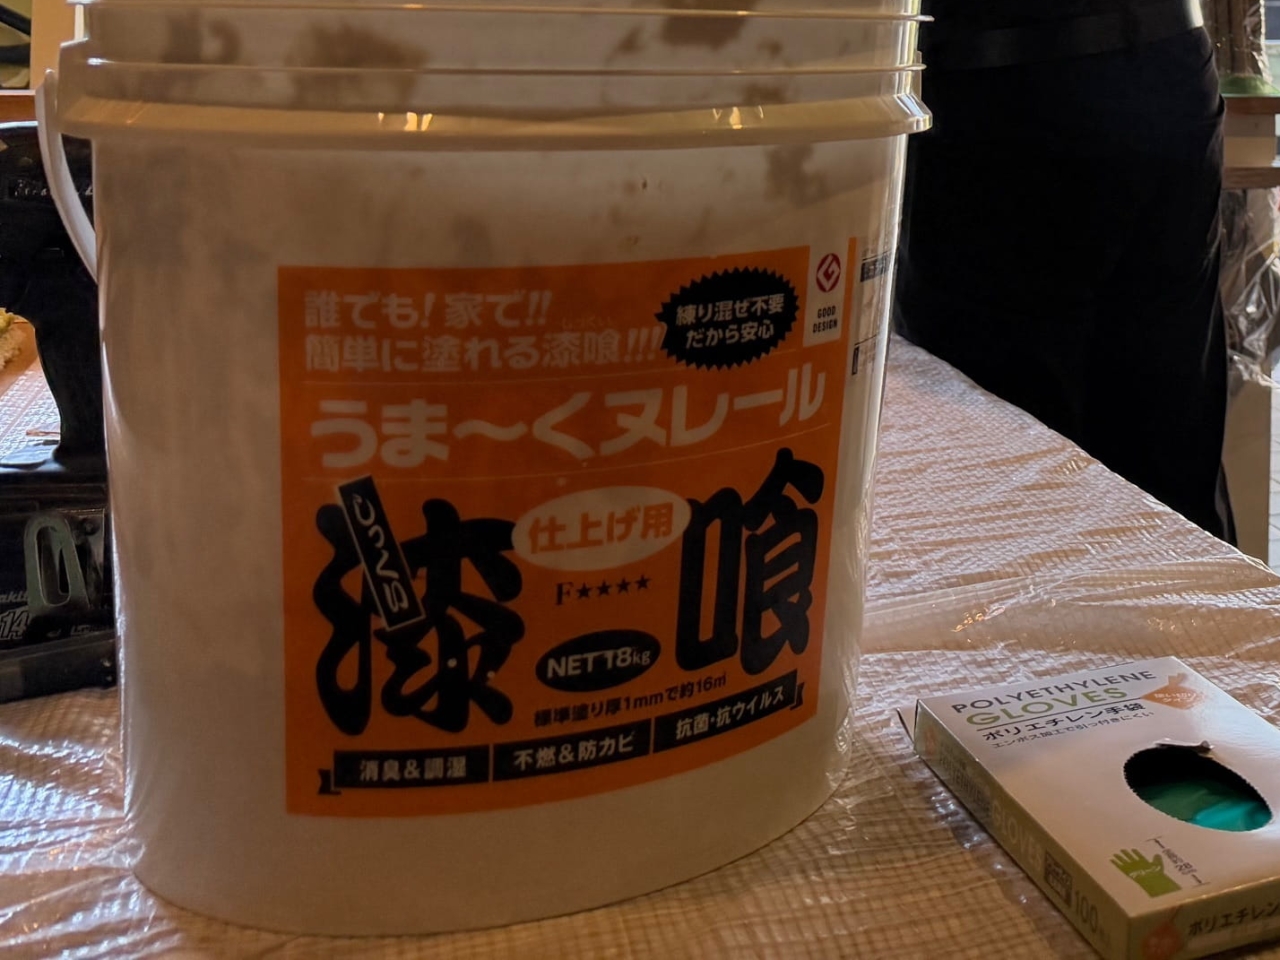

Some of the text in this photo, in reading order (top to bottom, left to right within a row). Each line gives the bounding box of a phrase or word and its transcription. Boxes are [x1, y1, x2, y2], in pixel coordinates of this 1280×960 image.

[676, 293, 785, 327] 練り混ぜ不要
[812, 319, 838, 333] DESIGN
[817, 305, 837, 319] GOOD
[685, 319, 775, 350] だから安心
[528, 502, 674, 554] 仕上げ用
[951, 670, 1158, 714] POLYETHYLENE
[966, 686, 1129, 726] GLOVES
[982, 702, 1148, 741] ポリエチレン手袋
